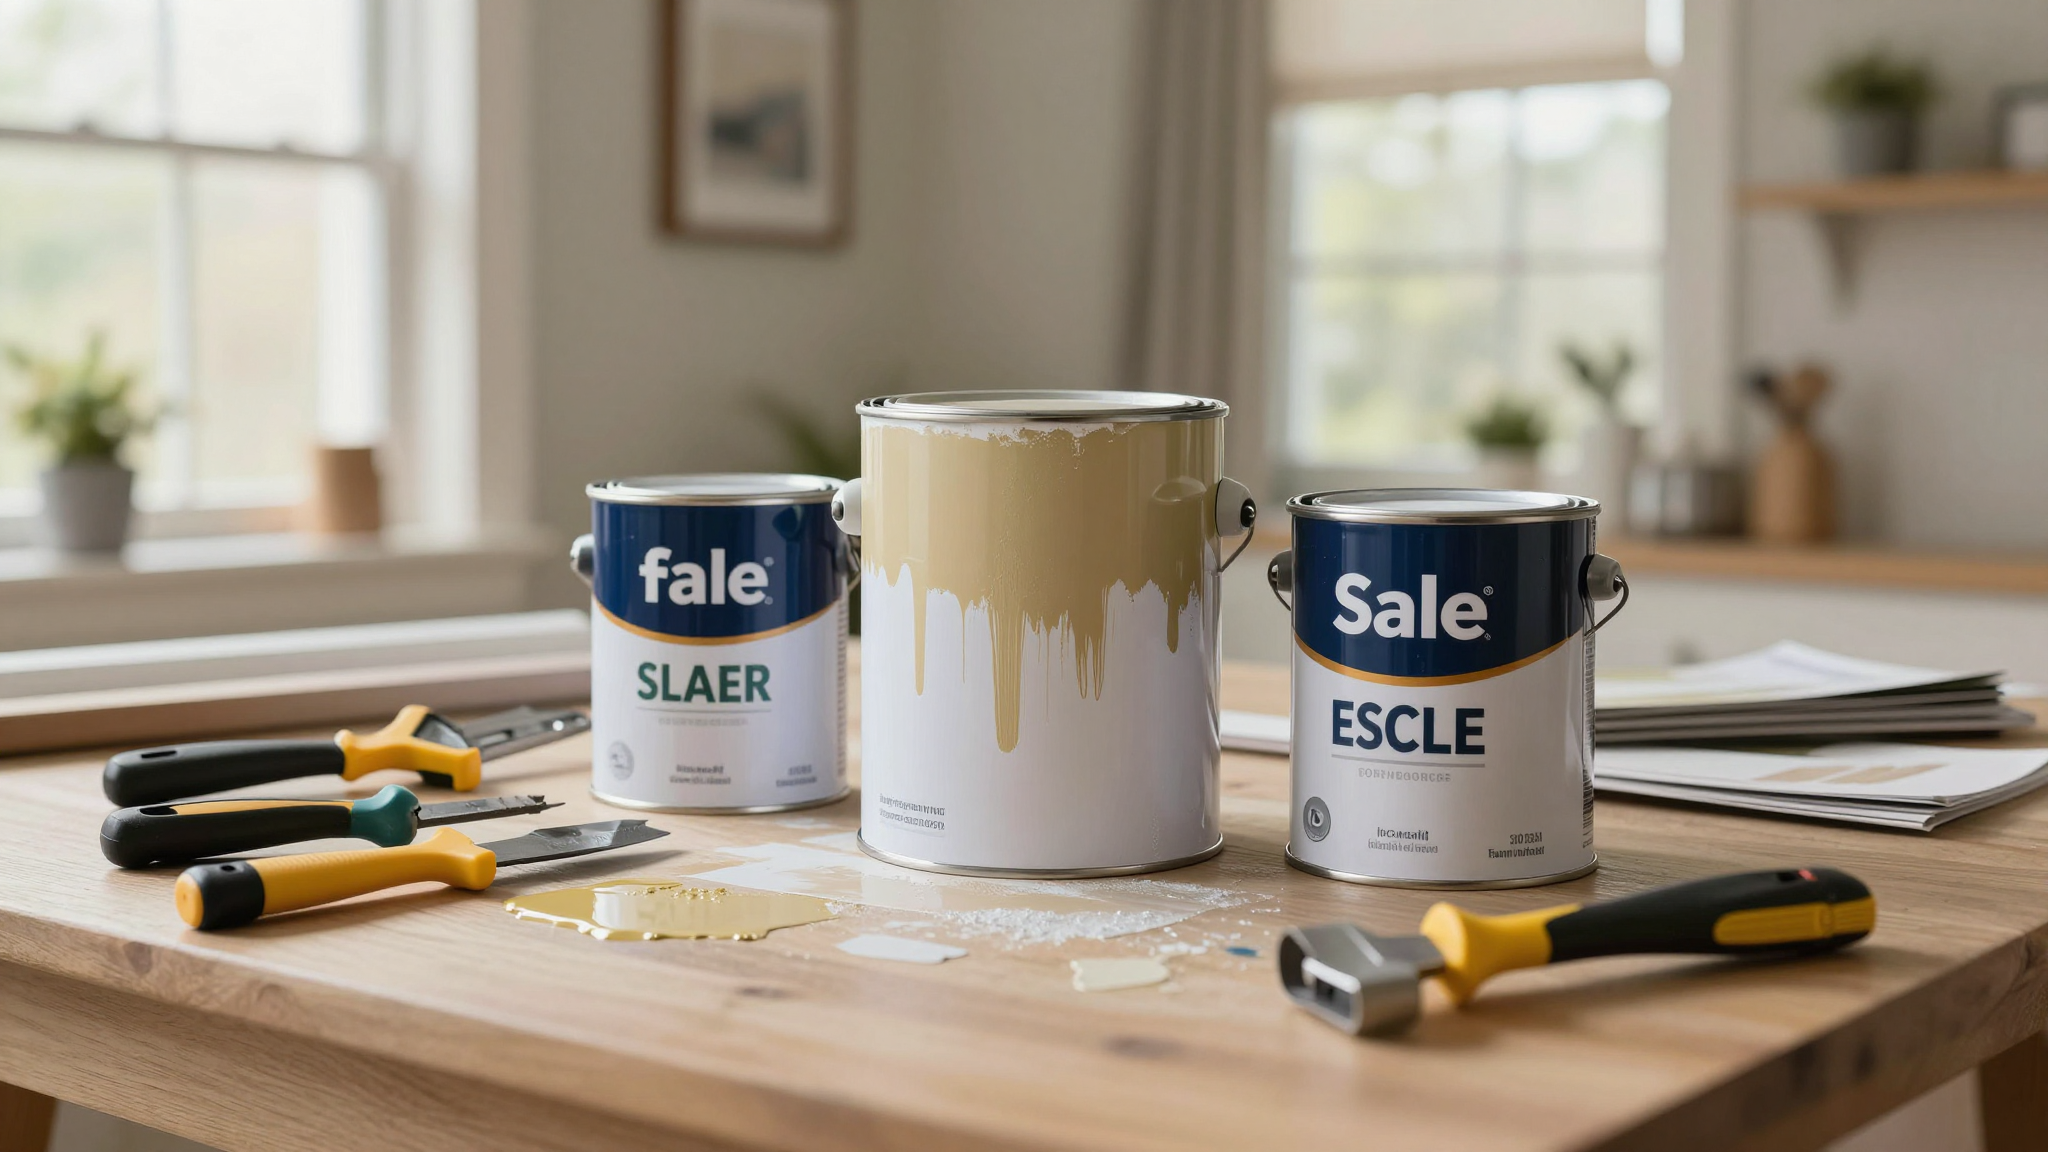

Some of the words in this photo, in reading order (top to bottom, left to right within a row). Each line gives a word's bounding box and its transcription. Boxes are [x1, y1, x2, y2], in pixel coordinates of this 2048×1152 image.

[638, 546, 770, 606] fale
[1332, 572, 1490, 641] Sale
[636, 661, 772, 704] SLAER
[1331, 699, 1486, 755] ESCLE
